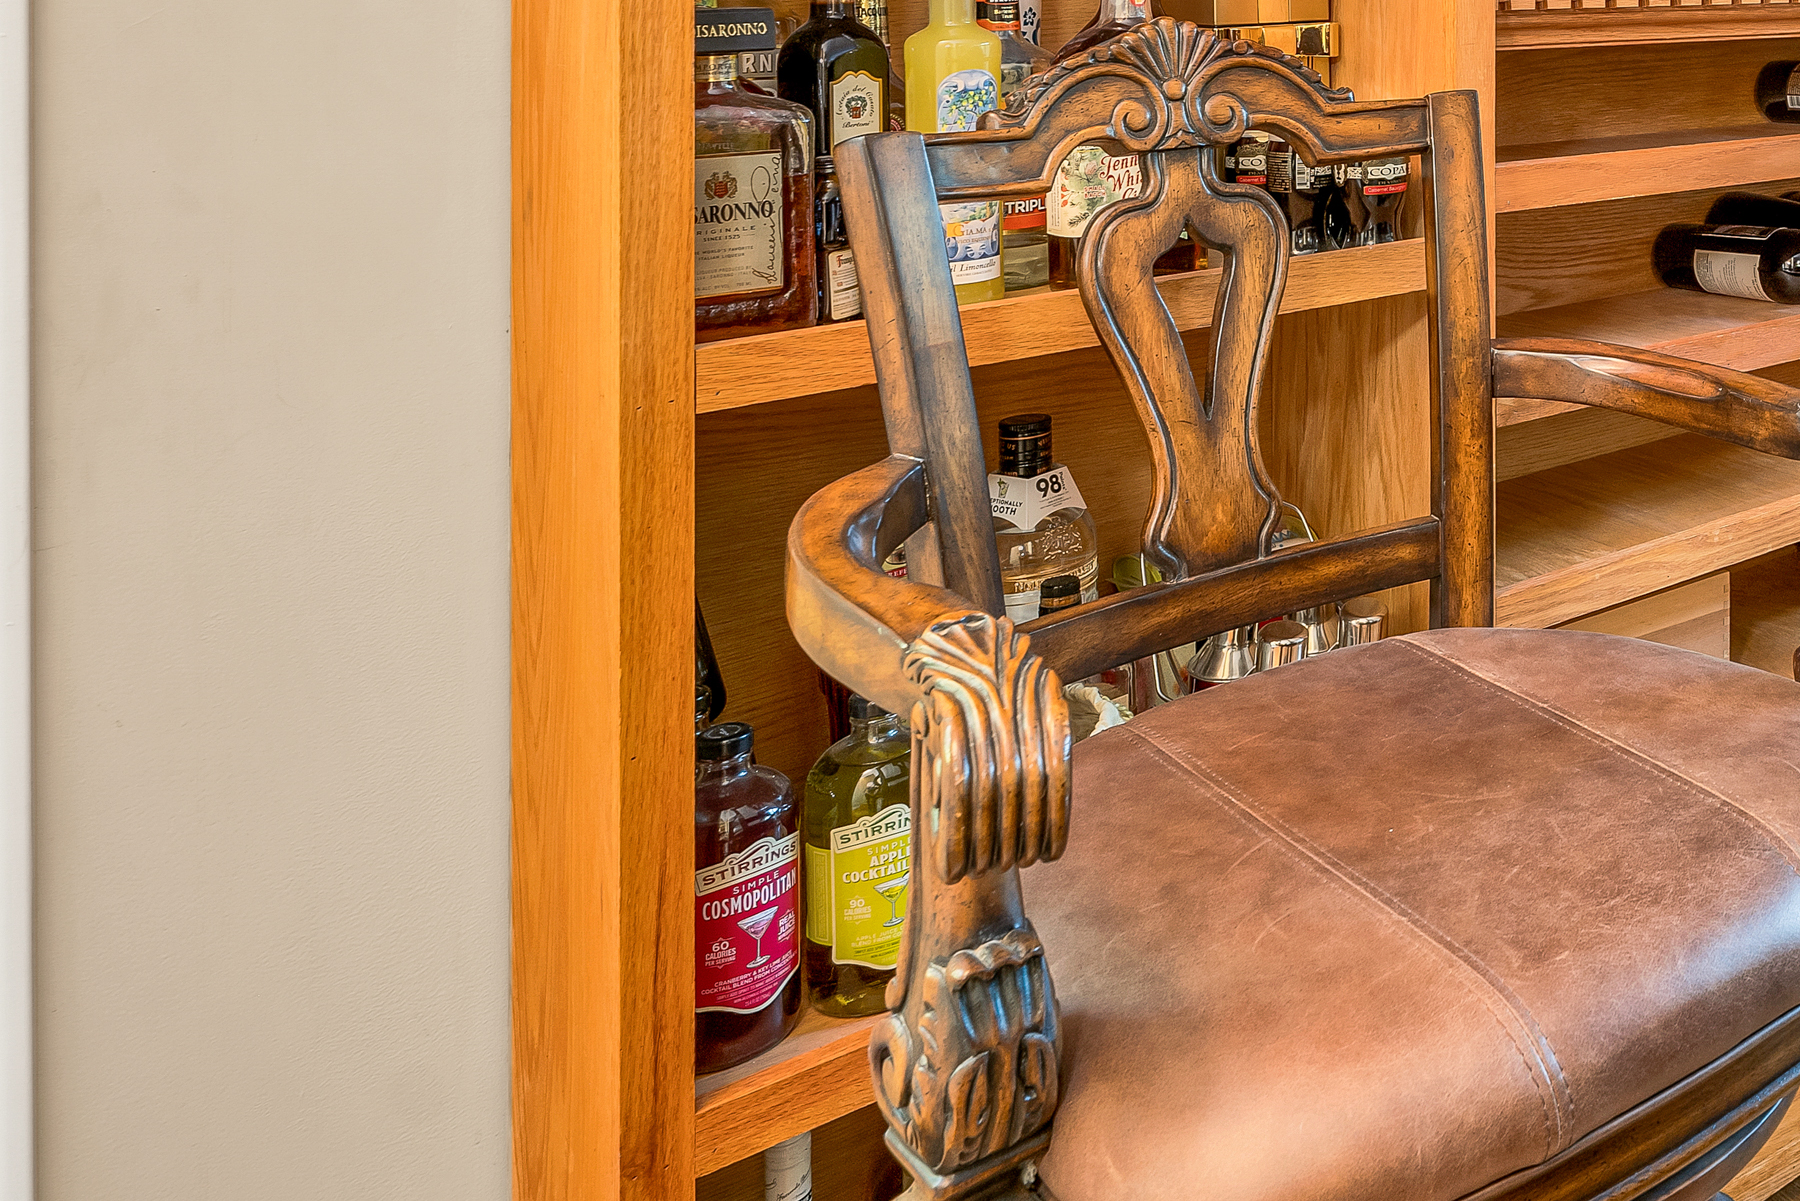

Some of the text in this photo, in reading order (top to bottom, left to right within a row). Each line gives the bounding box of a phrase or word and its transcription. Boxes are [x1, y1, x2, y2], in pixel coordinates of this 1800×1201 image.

[695, 22, 768, 38] ISARONNO
[742, 53, 779, 73] RN
[1369, 165, 1406, 177] COPA
[696, 225, 756, 236] RIGINALE
[1036, 474, 1062, 498] 98
[990, 505, 1017, 515] OOTH
[702, 841, 796, 886] STIRRINGS
[842, 859, 910, 884] COCKTAIL
[732, 869, 779, 895] SIMPLE
[702, 866, 797, 921] COSMOPOLITAN
[844, 905, 872, 916] CALORIES
[849, 898, 865, 909] 90
[705, 947, 737, 961] CALORIES
[712, 940, 730, 952] 60
[701, 984, 731, 996] COCKTAIL
[732, 977, 753, 989] BLEND
[753, 968, 770, 981] FROM
[714, 972, 752, 988] CRANBERRY
[757, 965, 769, 974] KEY
